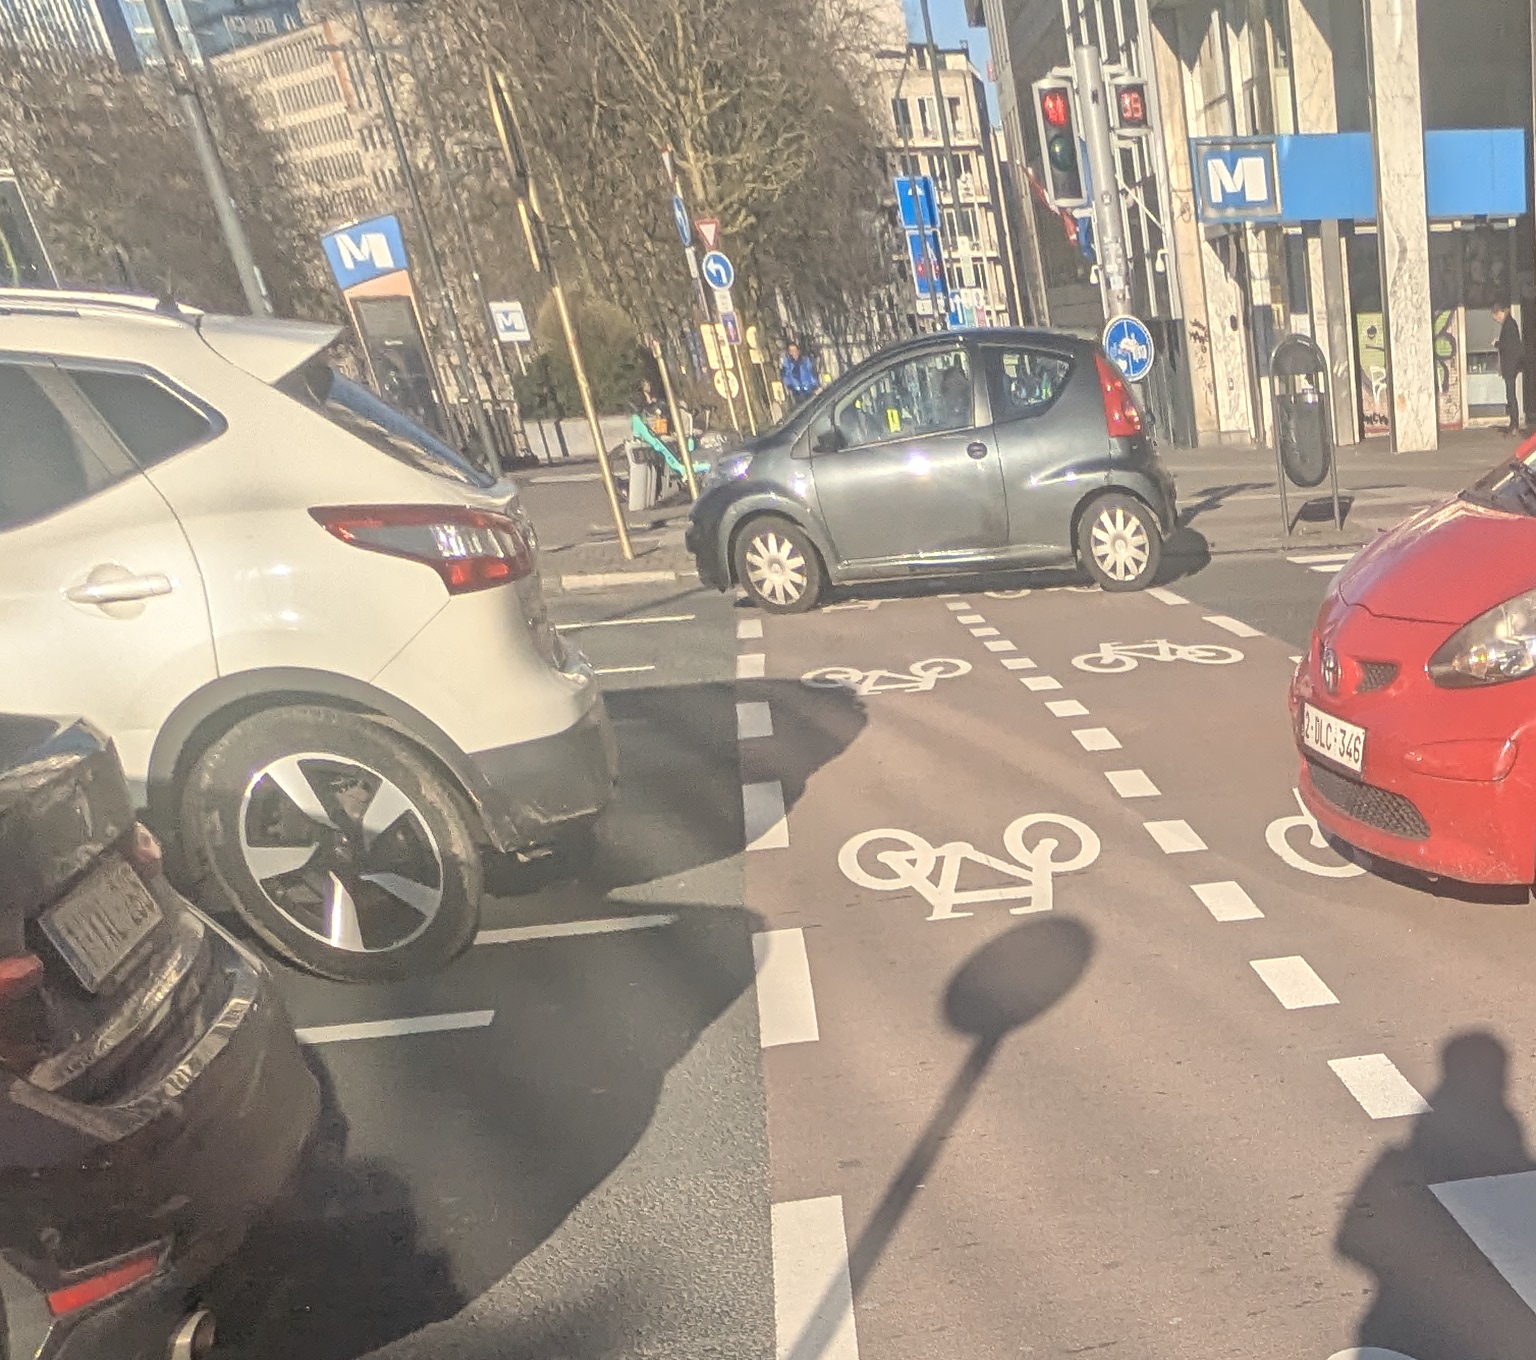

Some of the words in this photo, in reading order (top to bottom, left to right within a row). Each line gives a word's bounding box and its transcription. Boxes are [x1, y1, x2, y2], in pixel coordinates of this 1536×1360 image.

[1207, 157, 1268, 203] M
[334, 232, 394, 270] M
[495, 311, 526, 331] M
